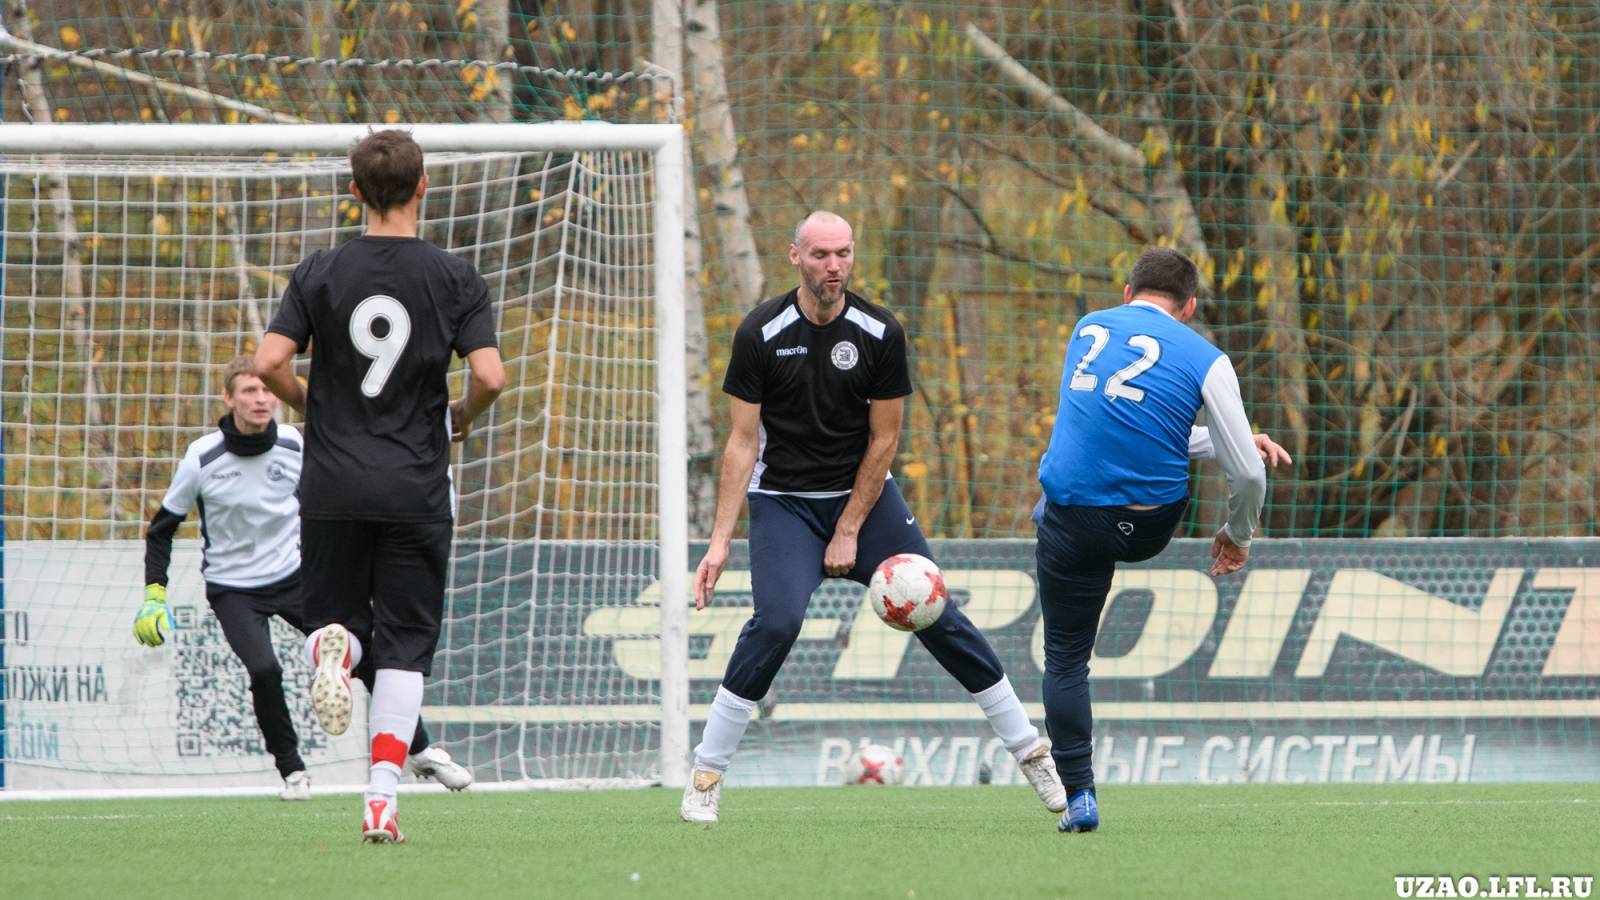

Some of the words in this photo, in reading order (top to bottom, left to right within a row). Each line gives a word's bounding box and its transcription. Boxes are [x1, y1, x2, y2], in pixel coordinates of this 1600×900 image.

[349, 294, 411, 397] 9
[776, 345, 808, 357] macron
[1069, 324, 1161, 402] 22
[77, 664, 108, 703] НА
[816, 736, 1185, 786] ВХЛОЫЕ
[1199, 734, 1476, 784] СИСТЕМЫ
